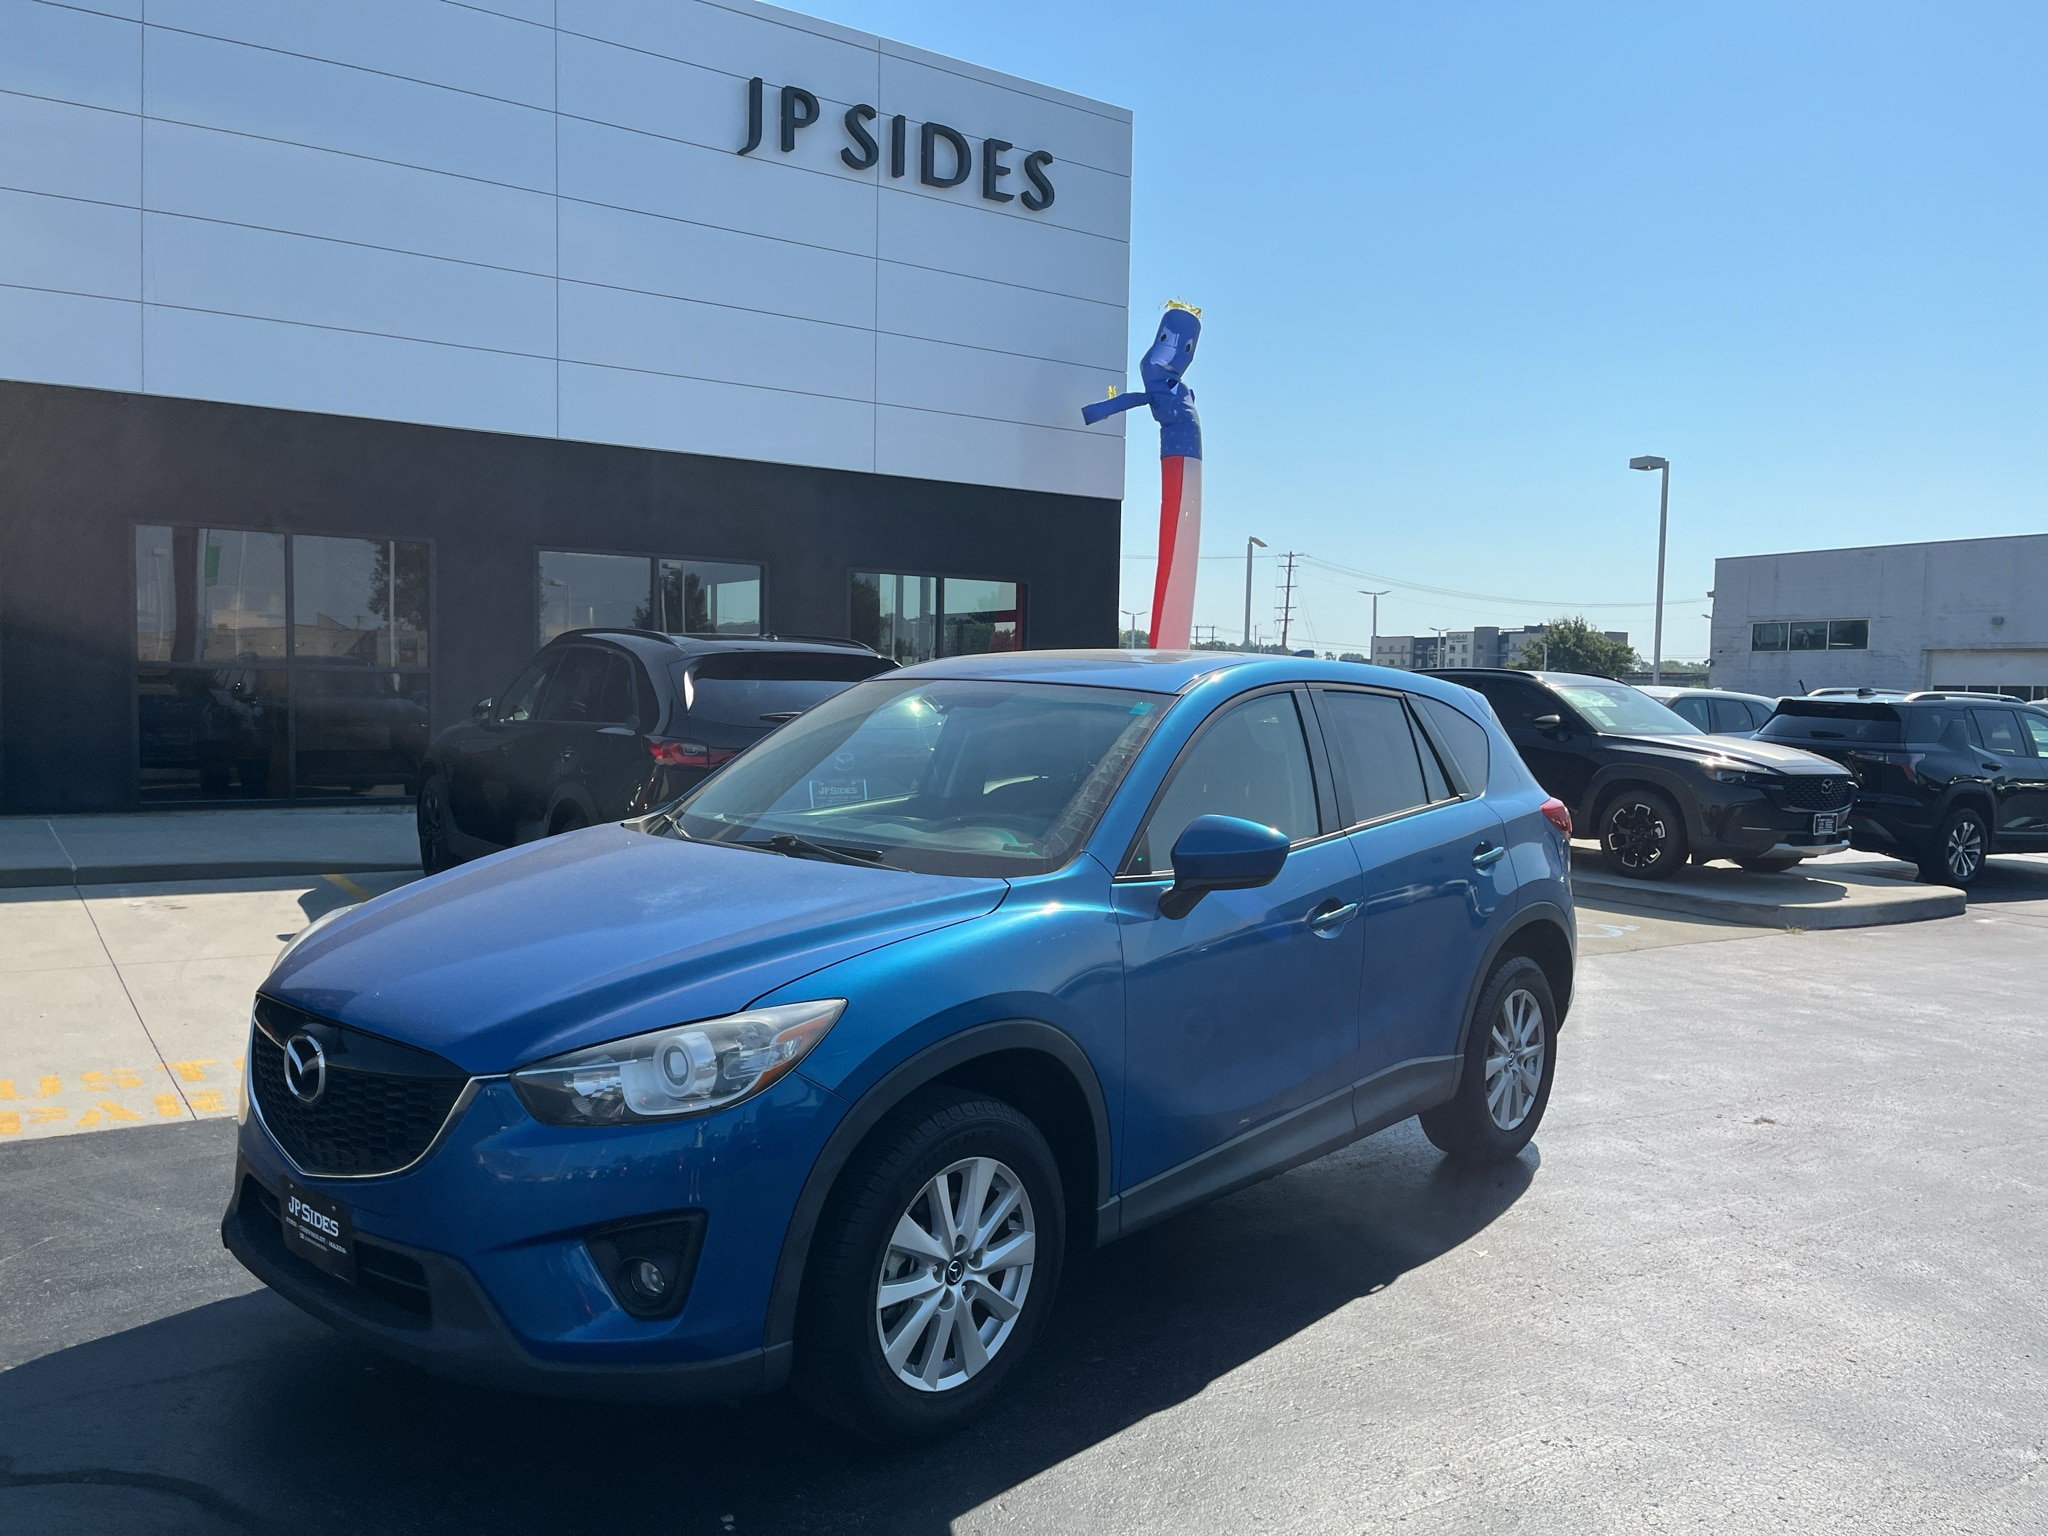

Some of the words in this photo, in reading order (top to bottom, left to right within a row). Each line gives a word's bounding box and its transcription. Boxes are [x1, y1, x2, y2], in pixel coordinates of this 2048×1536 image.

[737, 77, 820, 155] JP
[840, 103, 1055, 212] SIDES
[288, 1196, 301, 1216] JP
[302, 1203, 339, 1237] SIDES
